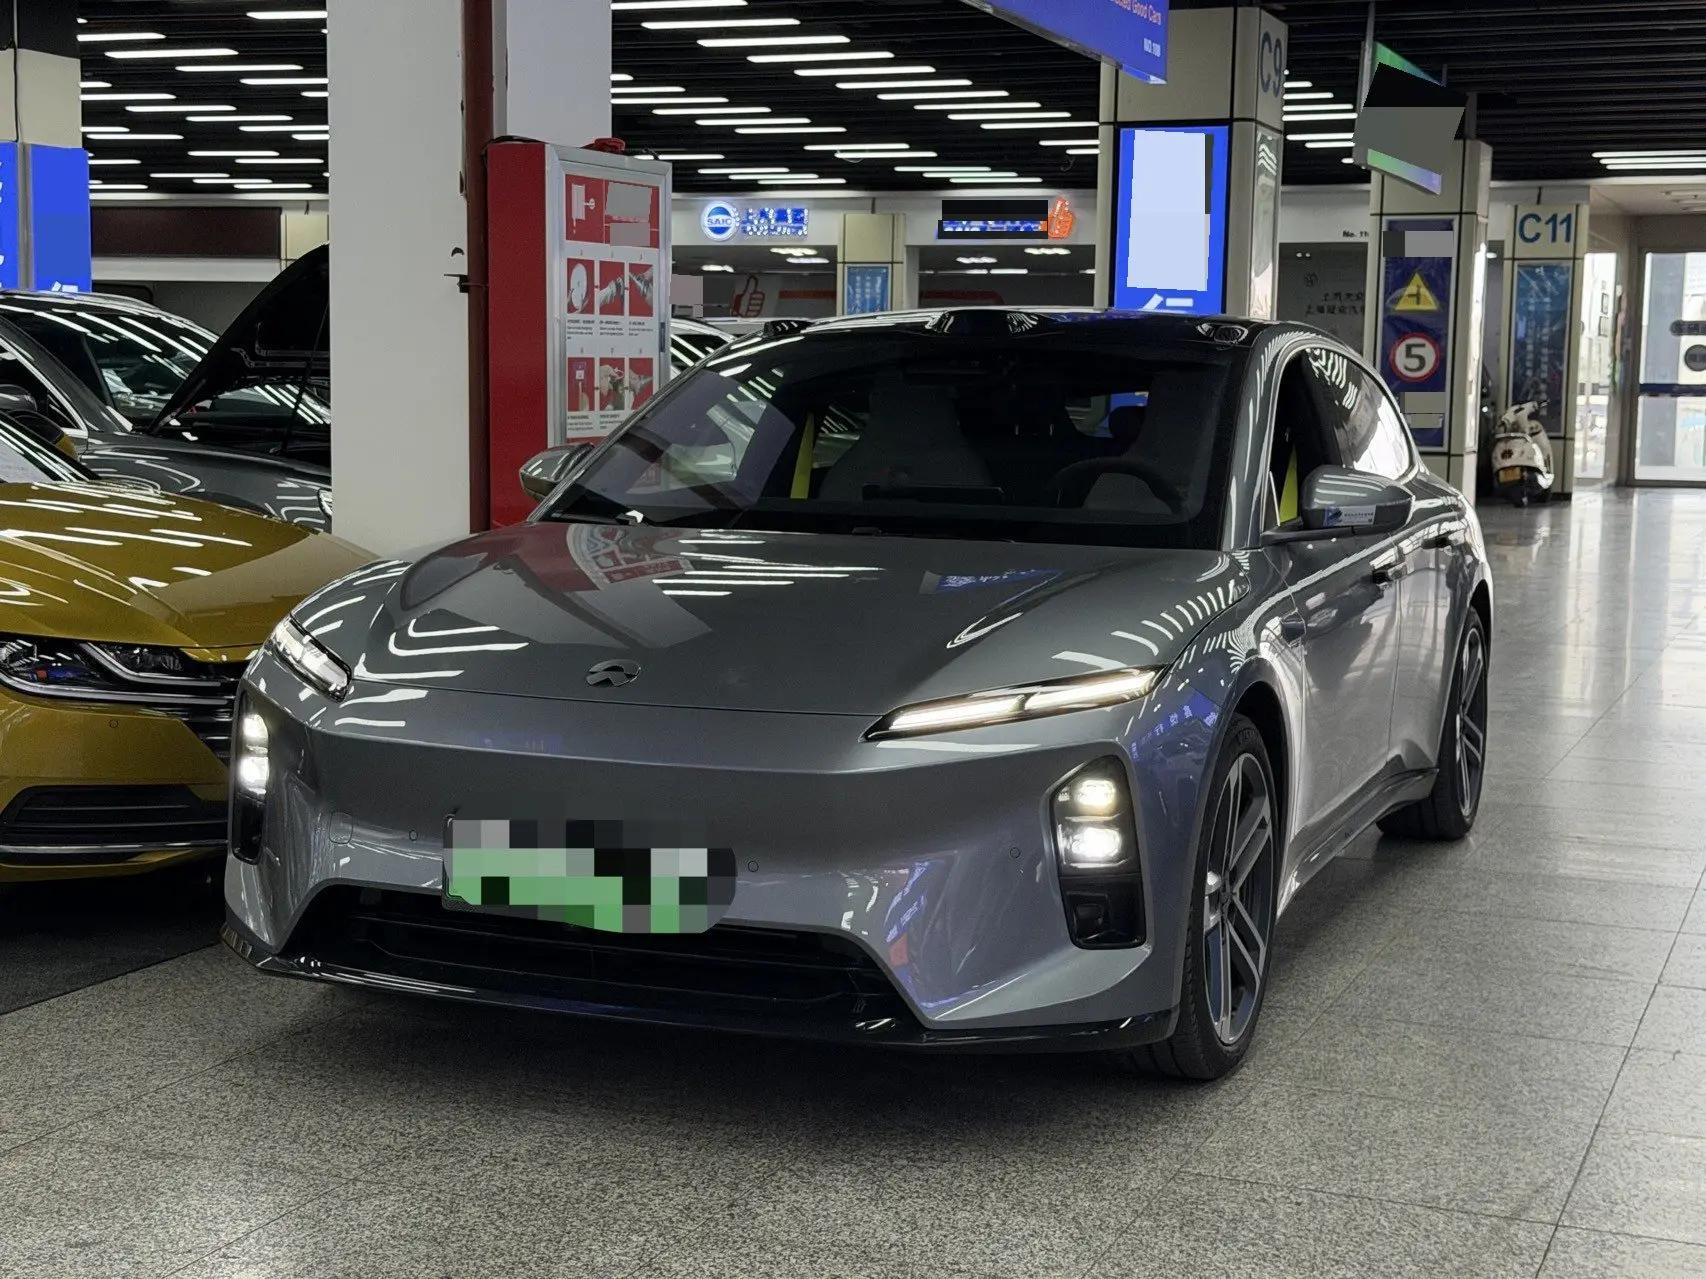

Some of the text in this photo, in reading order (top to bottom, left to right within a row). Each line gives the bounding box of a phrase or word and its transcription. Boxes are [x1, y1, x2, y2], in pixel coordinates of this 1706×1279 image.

[1260, 31, 1283, 98] C9
[1518, 213, 1573, 243] C11
[1404, 343, 1427, 373] 5
